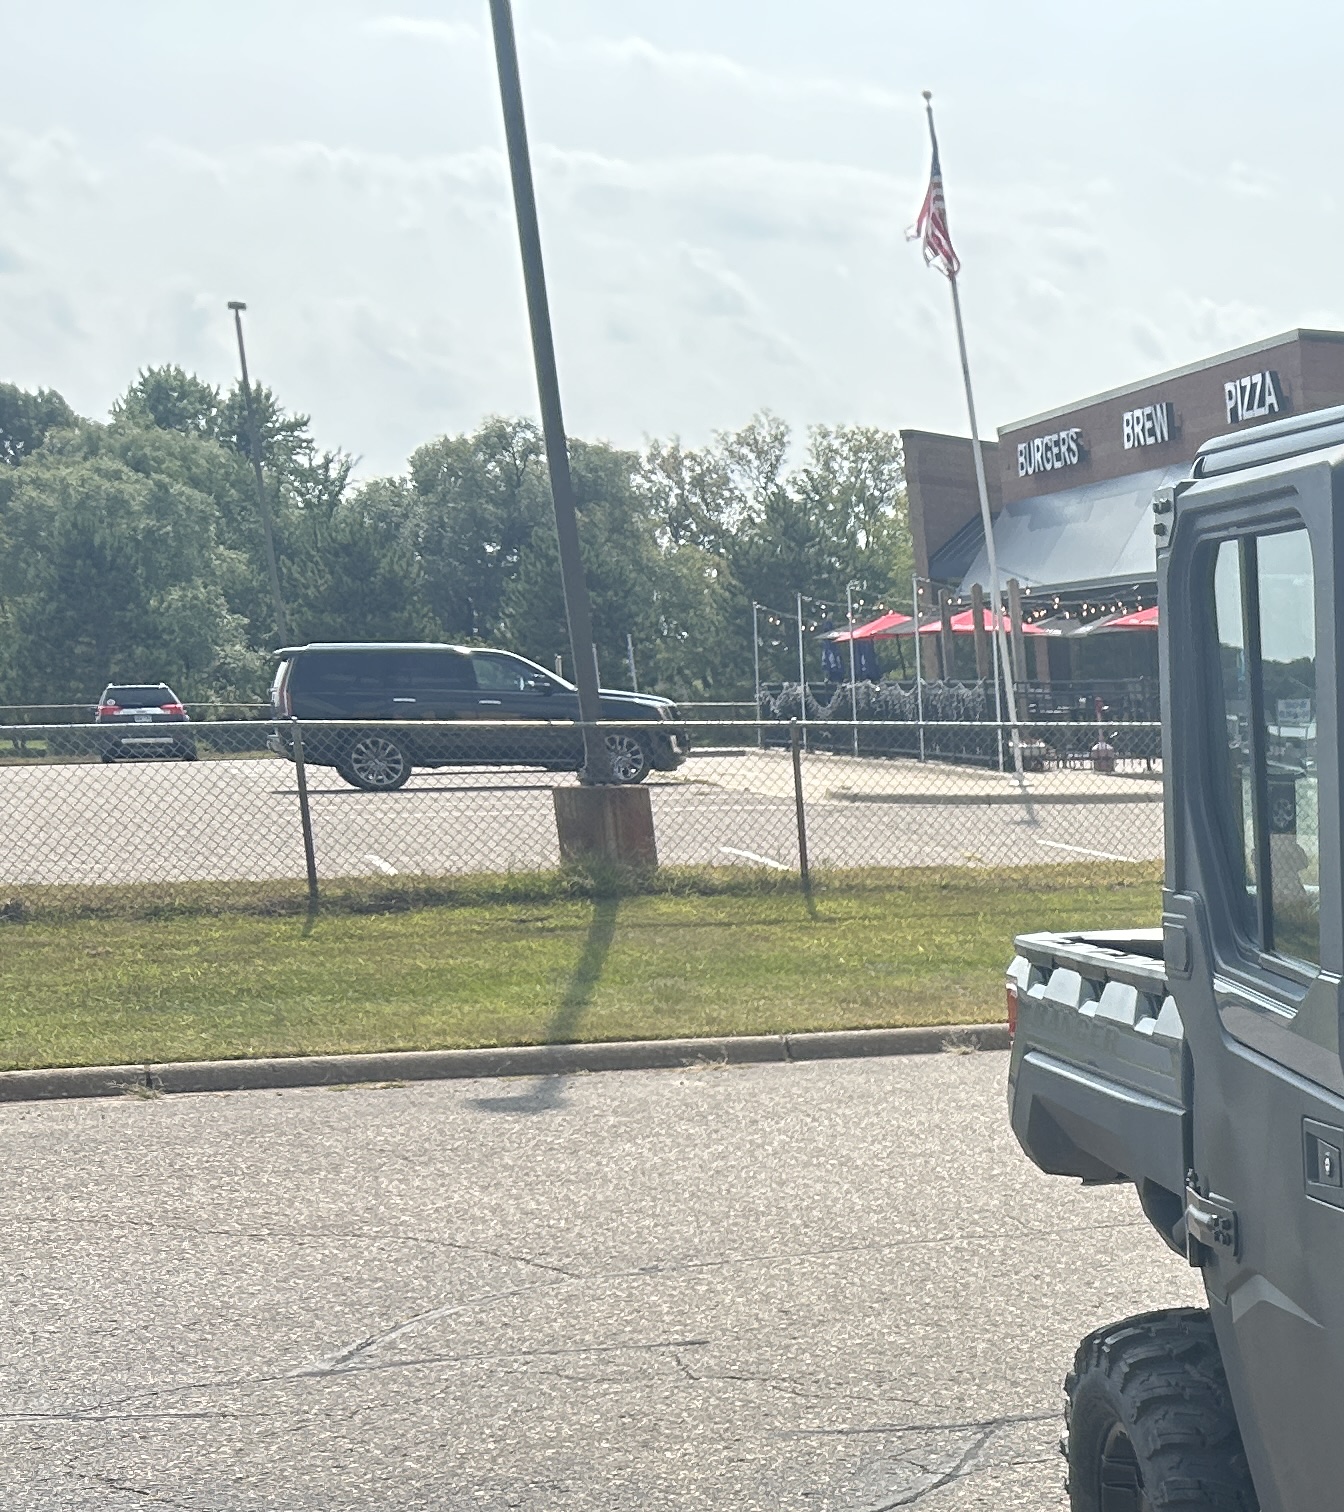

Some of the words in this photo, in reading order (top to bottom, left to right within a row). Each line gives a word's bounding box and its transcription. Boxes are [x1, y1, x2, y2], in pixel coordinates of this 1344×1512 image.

[1018, 428, 1080, 477] BURGERS
[1123, 403, 1169, 450] BREW
[1224, 371, 1279, 424] PIZZA
